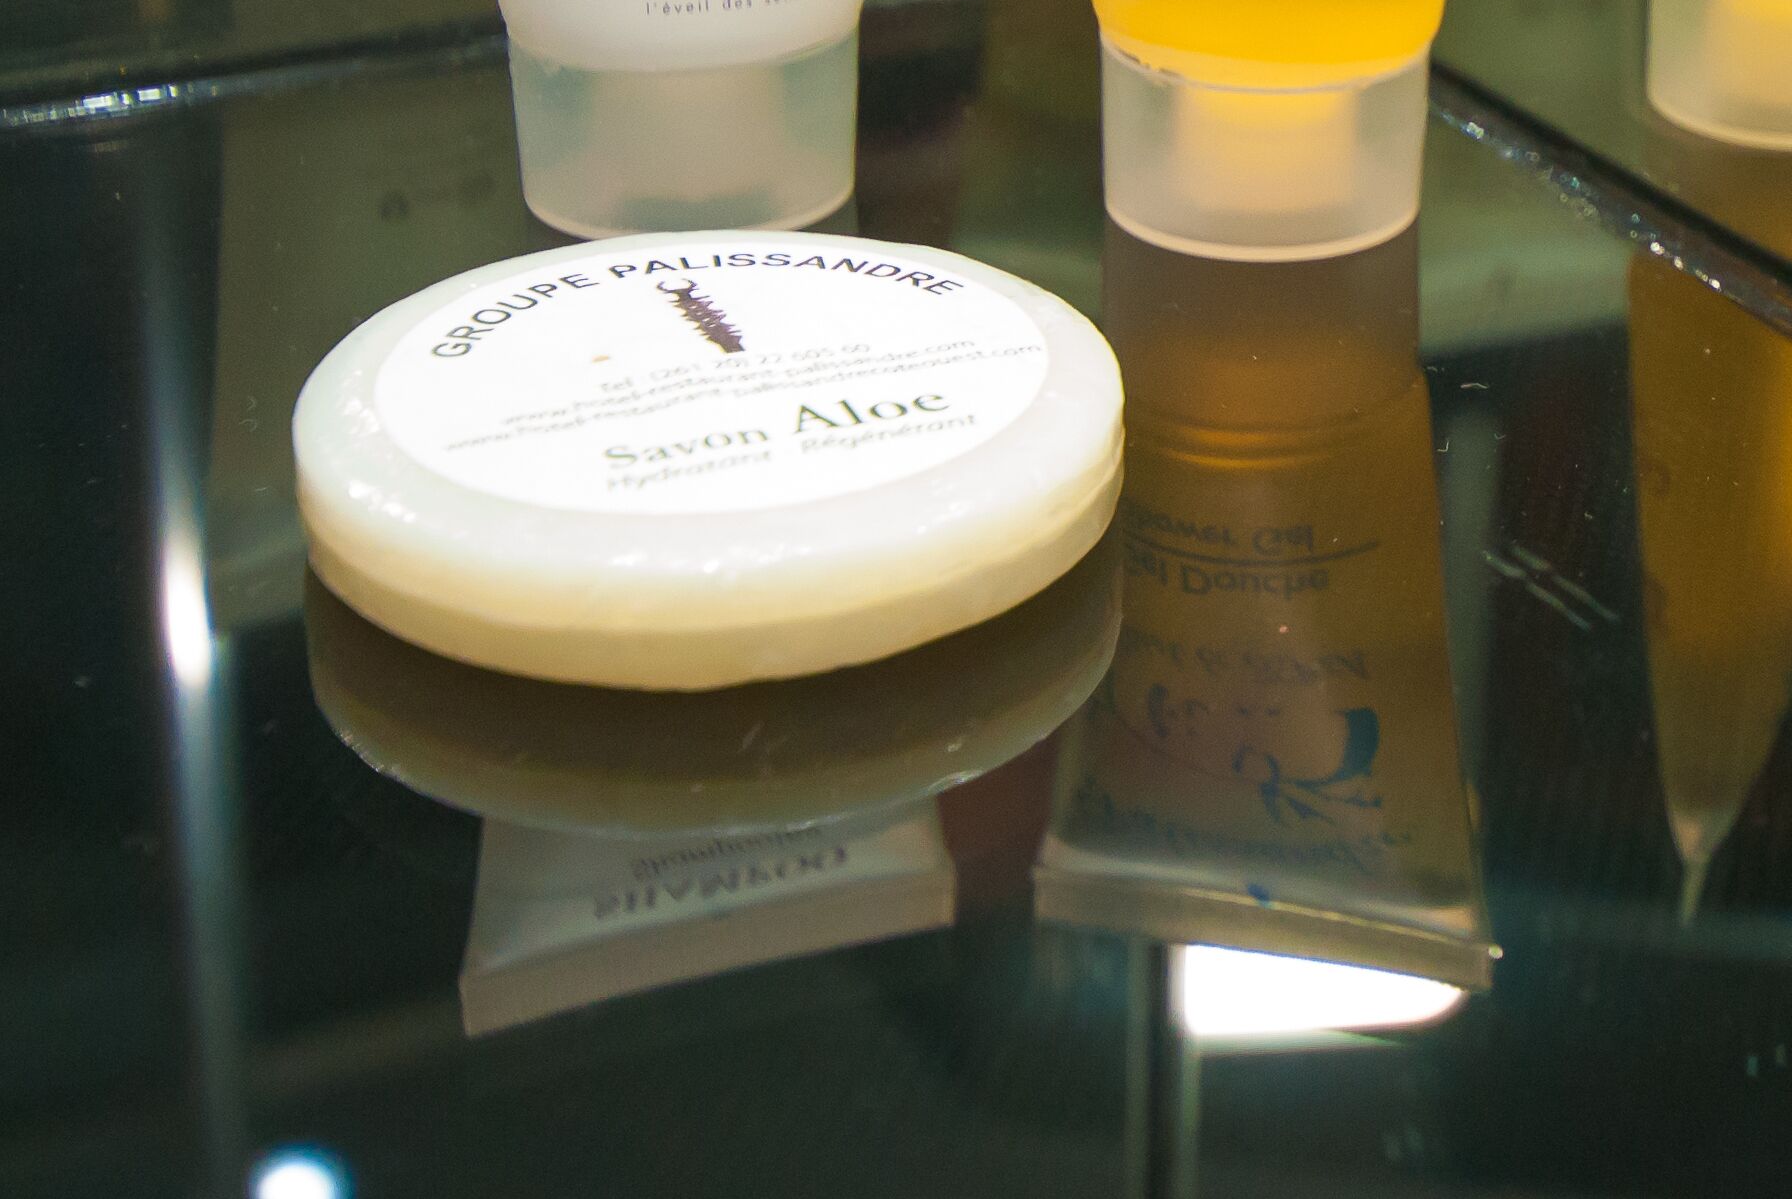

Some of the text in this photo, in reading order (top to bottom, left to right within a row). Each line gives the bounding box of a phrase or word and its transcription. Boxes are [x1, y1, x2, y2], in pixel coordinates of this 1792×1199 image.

[430, 252, 965, 360] GROUPE PALISSANDRE
[601, 393, 951, 470] Savon Aloe
